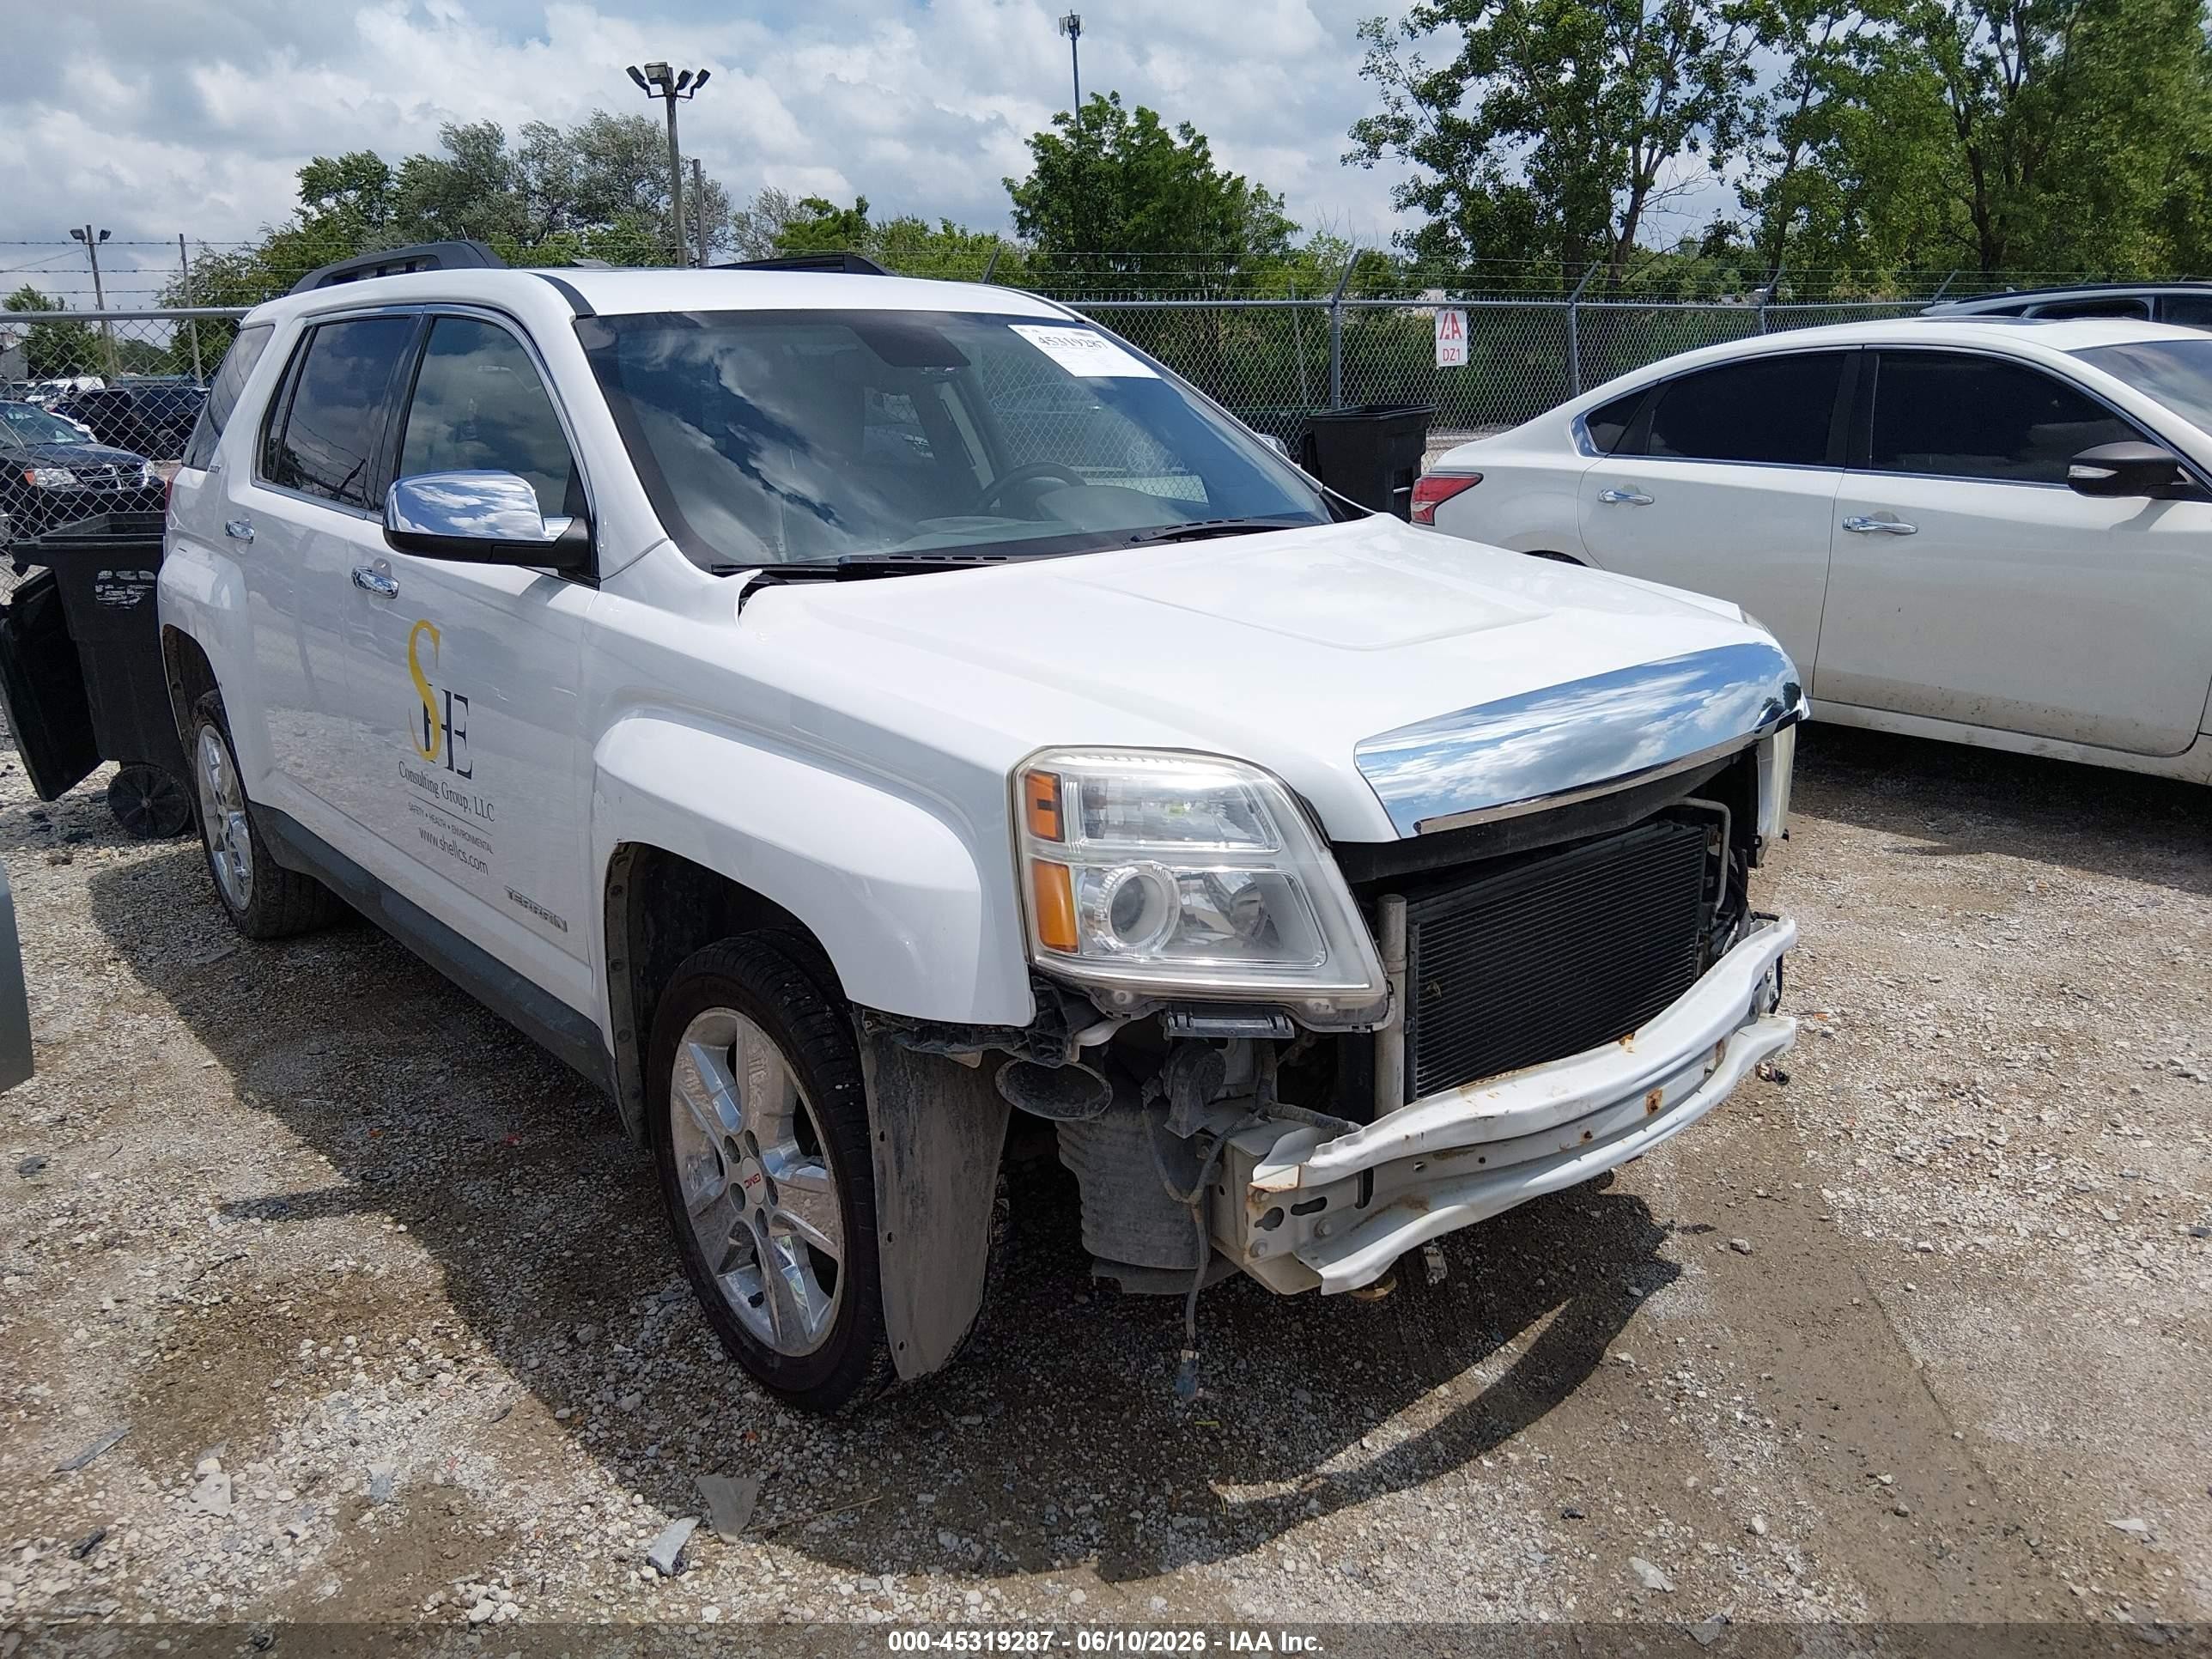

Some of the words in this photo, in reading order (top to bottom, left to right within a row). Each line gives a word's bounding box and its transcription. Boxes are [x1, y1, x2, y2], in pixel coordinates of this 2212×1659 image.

[1037, 335, 1109, 349] 45319287
[1443, 348, 1461, 362] DZ1
[398, 761, 440, 799] Consulting
[441, 781, 471, 815] Group,
[473, 795, 495, 823] LLC
[408, 802, 424, 819] SAFETY
[428, 812, 447, 830] HEALTH
[451, 824, 494, 855] ENVIRONMENTAL
[503, 885, 568, 933] TERRAIN
[743, 1173, 762, 1189] GMC
